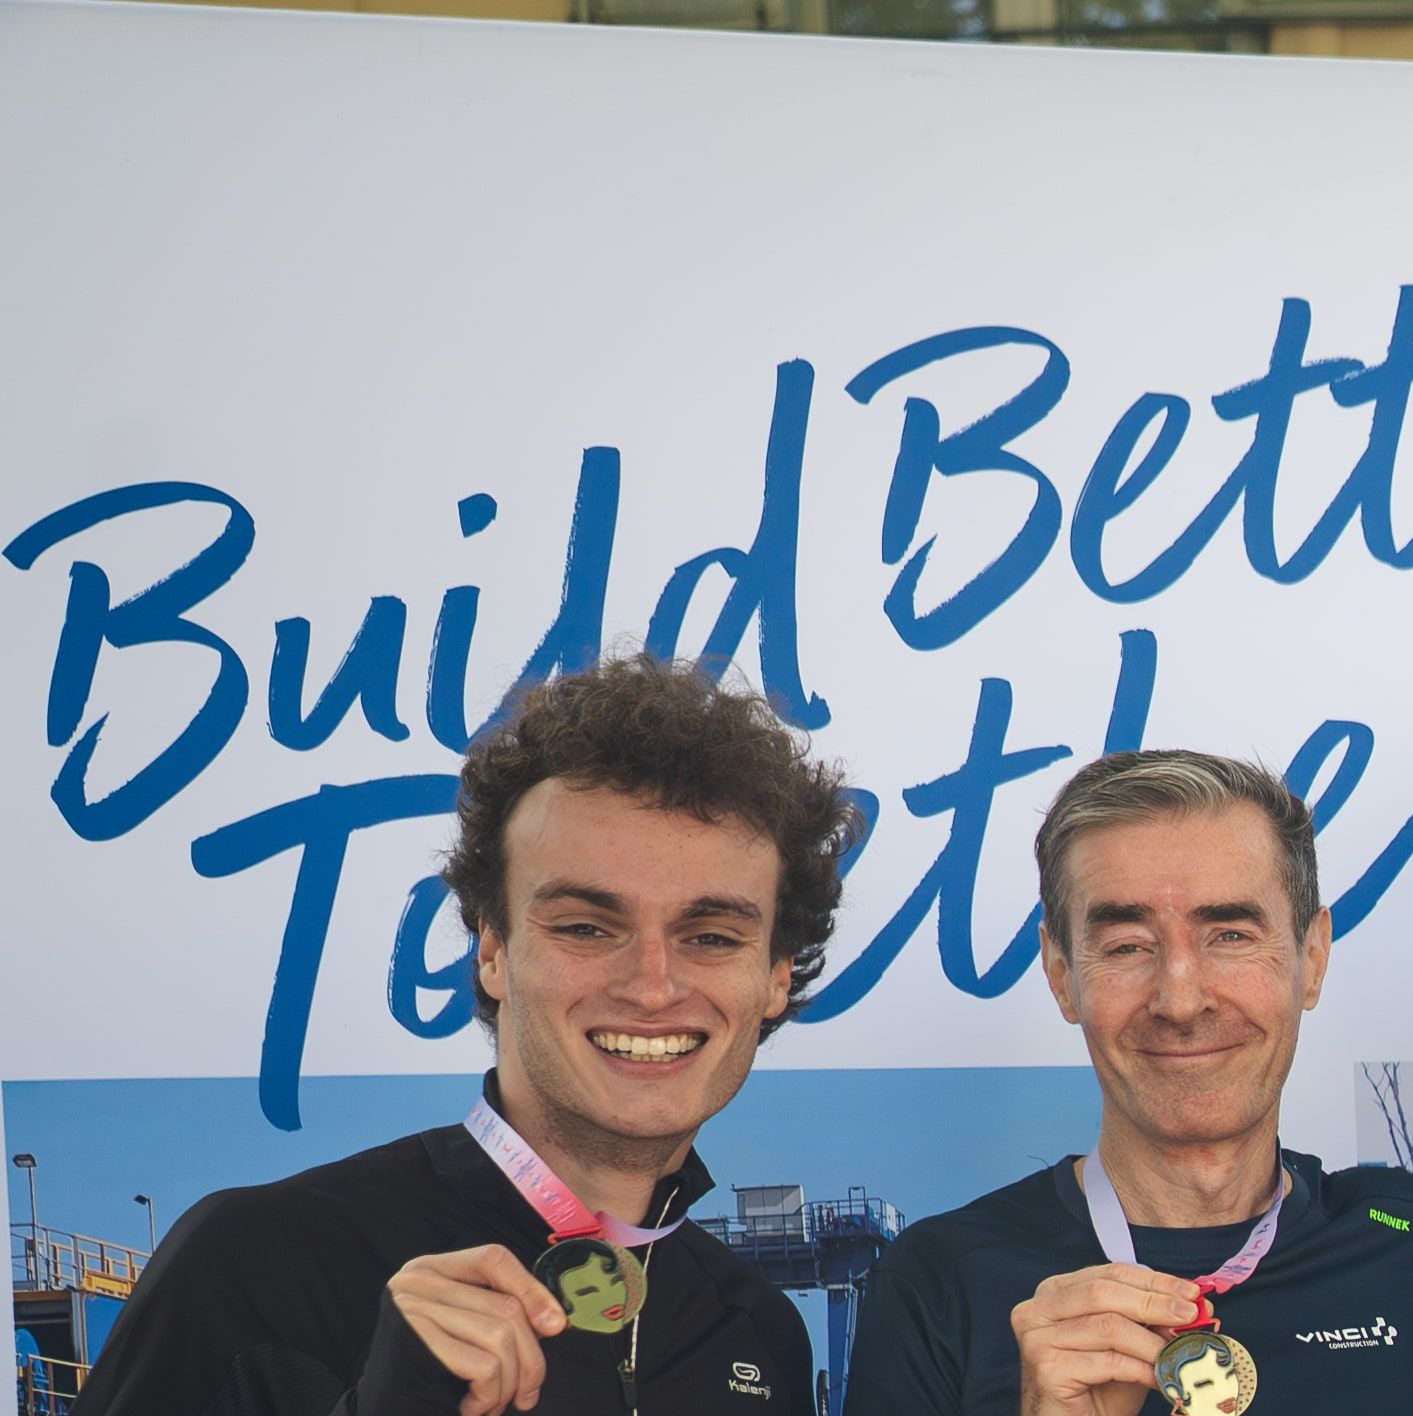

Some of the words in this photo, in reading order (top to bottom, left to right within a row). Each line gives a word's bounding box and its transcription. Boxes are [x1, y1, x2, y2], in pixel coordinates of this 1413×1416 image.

[2, 358, 832, 842] Build
[1369, 1208, 1411, 1232] RUNNEK
[1295, 1327, 1369, 1343] VINCI
[1328, 1339, 1379, 1350] CONSTRUCTION
[728, 1379, 772, 1400] Kalenji
